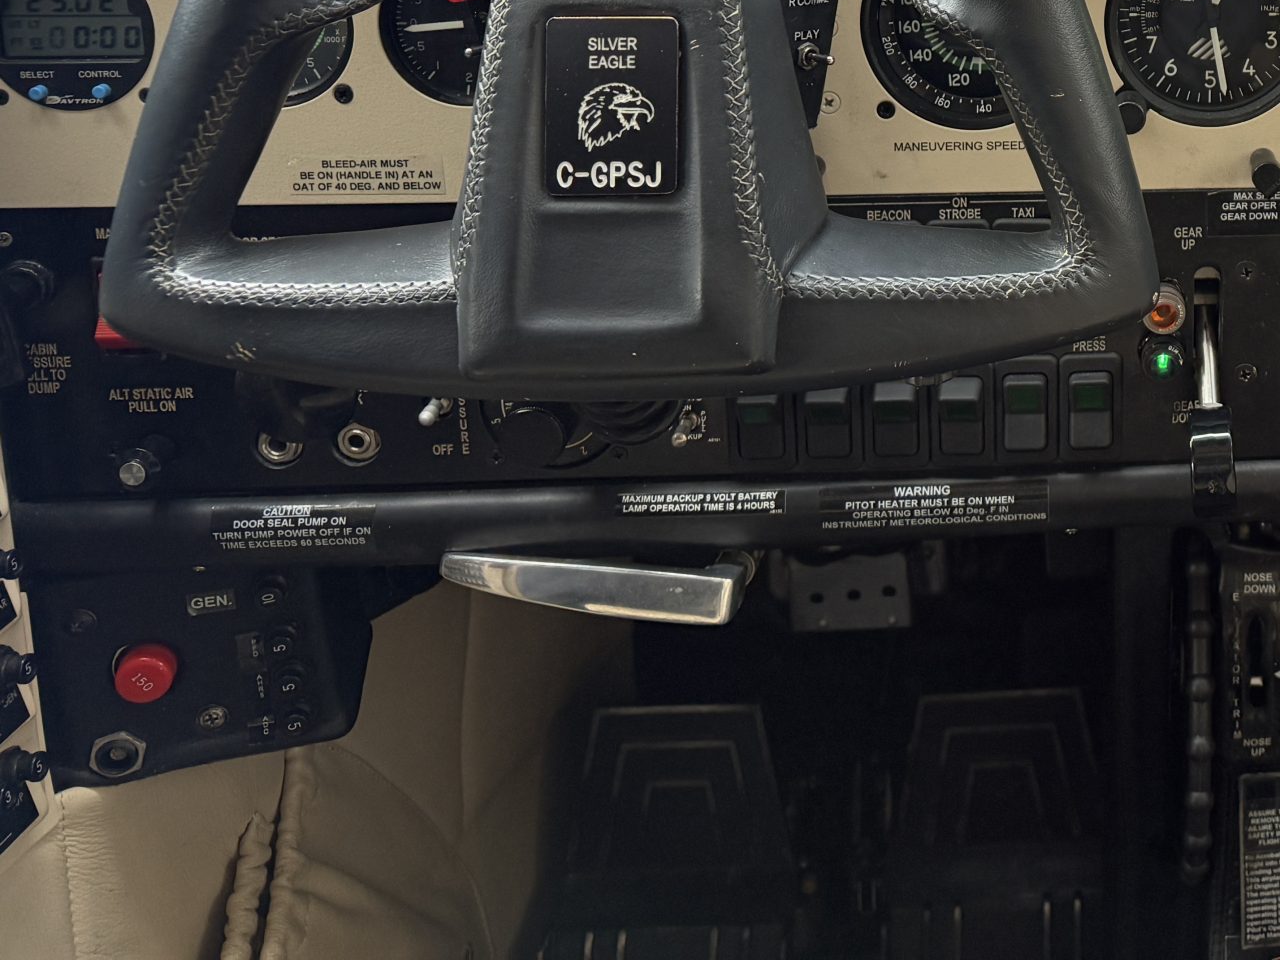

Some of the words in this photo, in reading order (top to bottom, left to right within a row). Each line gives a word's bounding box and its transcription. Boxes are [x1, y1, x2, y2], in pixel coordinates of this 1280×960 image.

[588, 37, 637, 50] SILVER
[589, 56, 636, 69] EAGLE
[20, 70, 54, 79] SELECT
[78, 70, 122, 79] CONTROL
[321, 160, 377, 169] BLEED-AIR
[380, 159, 409, 168] MUST
[556, 161, 662, 188] C-GPSJ
[867, 210, 911, 221] BEACON
[939, 209, 981, 219] STROBE
[1011, 208, 1035, 218] TAXI
[1174, 227, 1202, 238] GEAR
[1181, 240, 1195, 250] UP
[109, 389, 130, 400] ALT
[133, 388, 174, 399] STATIC
[177, 388, 194, 398] AIR
[894, 485, 951, 497] WARNING
[263, 507, 311, 517] CAUTION
[233, 520, 264, 529] DOOR
[267, 519, 295, 527] SEAL
[298, 518, 328, 526] PUMP
[331, 517, 346, 525] ON
[1244, 573, 1273, 582] NOSE
[1244, 584, 1276, 593] DOWN
